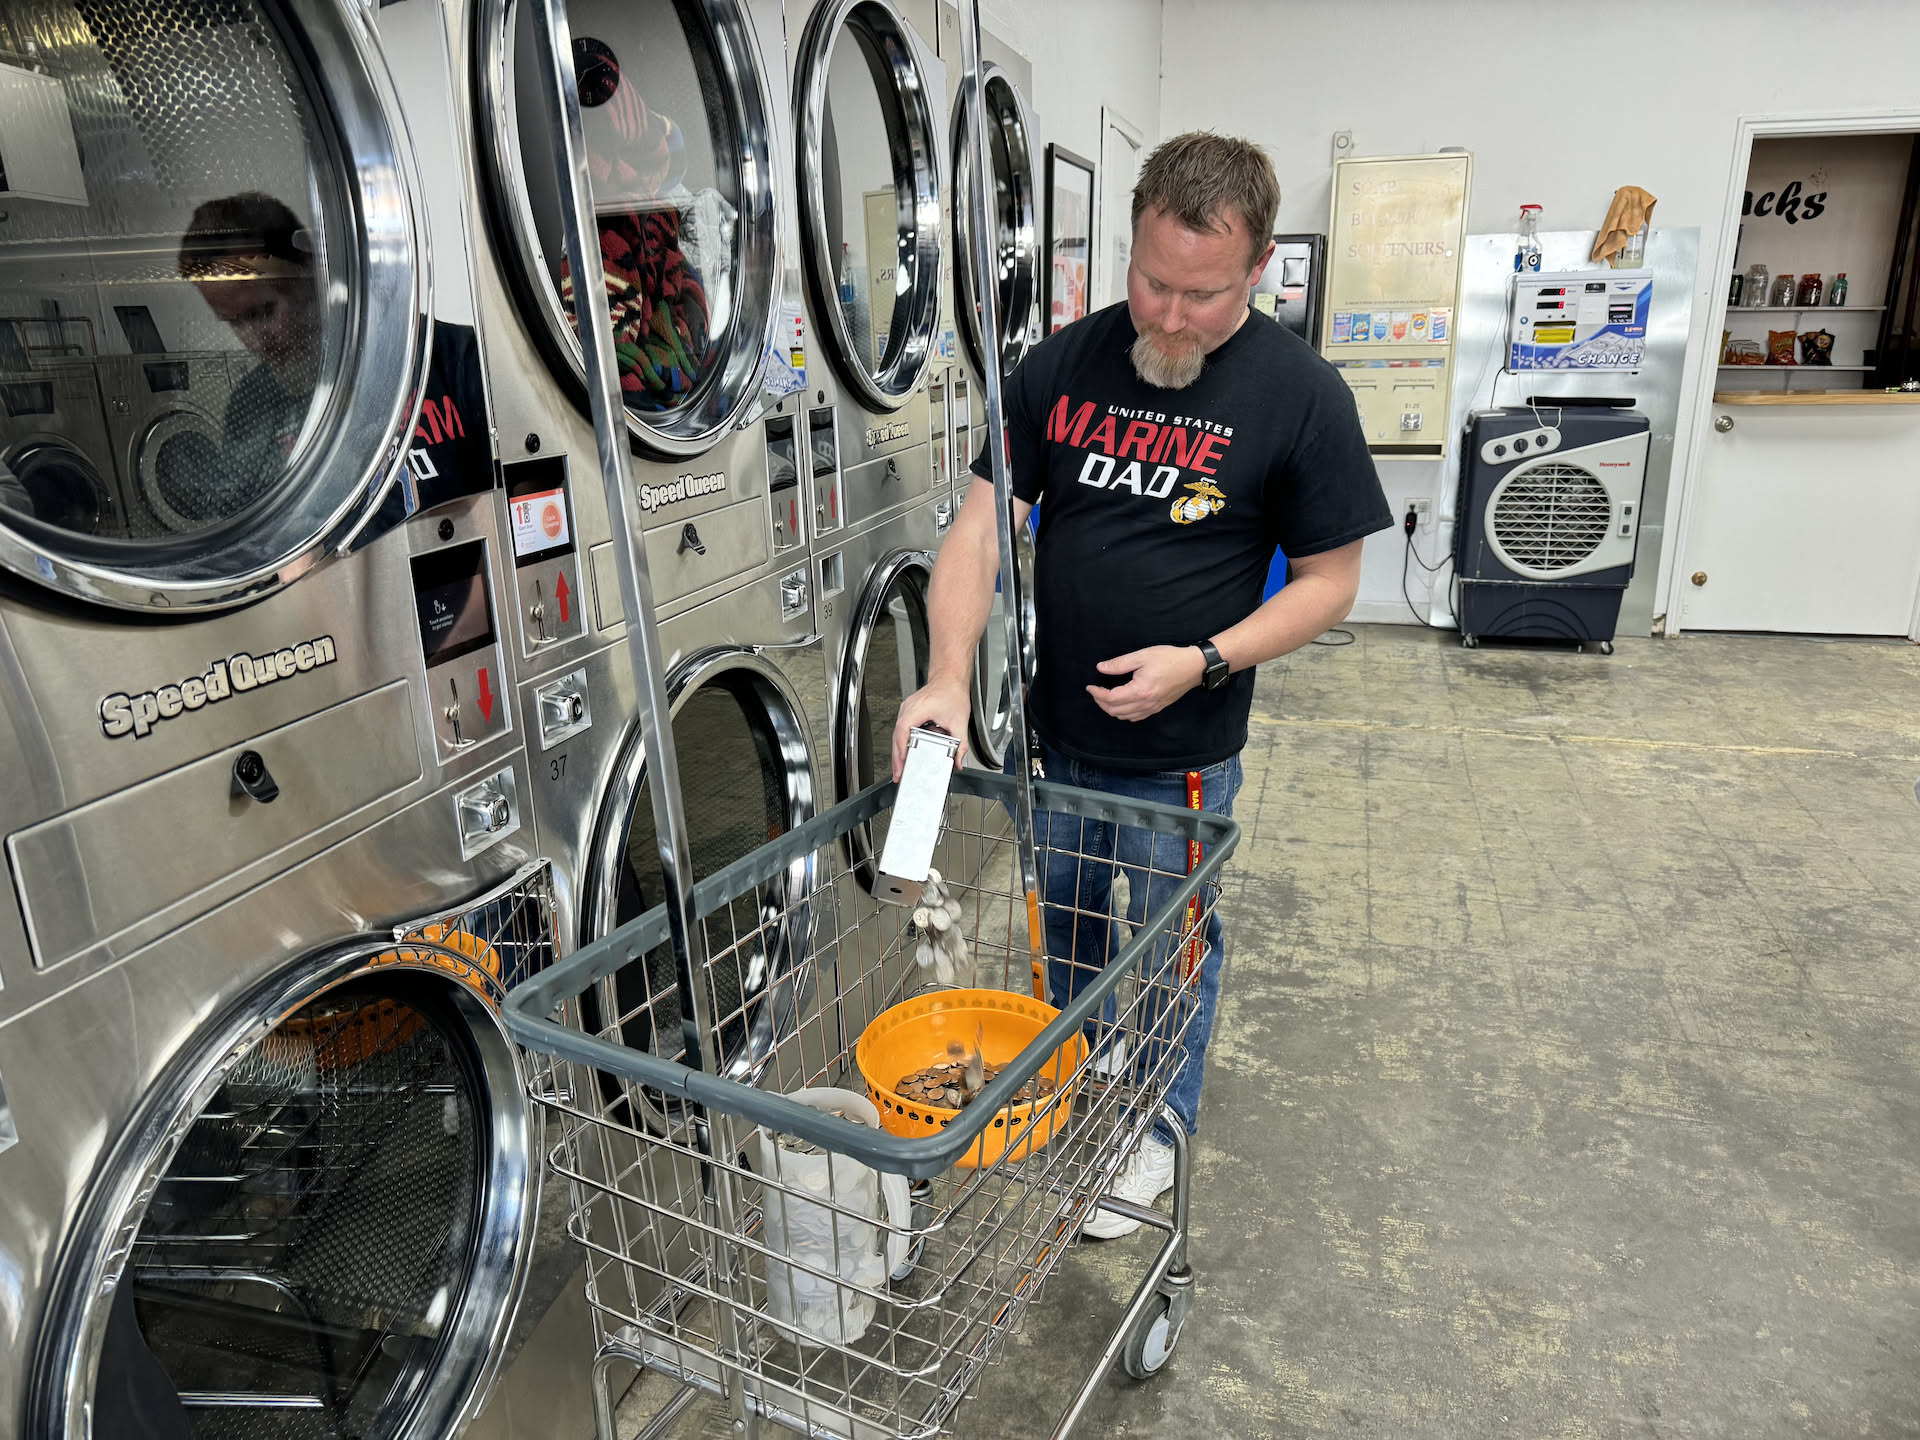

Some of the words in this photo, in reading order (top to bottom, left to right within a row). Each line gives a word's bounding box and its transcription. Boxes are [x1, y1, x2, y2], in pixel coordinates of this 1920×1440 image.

[1578, 353, 1640, 365] CHANGE
[1047, 394, 1231, 475] MARINE
[1108, 404, 1166, 424] UNITED
[1172, 415, 1235, 438] STATES
[639, 475, 686, 513] Speed
[684, 472, 726, 498] Queen
[1078, 452, 1180, 499] DAD
[823, 602, 833, 620] 39
[99, 659, 233, 740] Speed
[228, 635, 338, 693] Queen
[549, 754, 568, 782] 37
[1191, 789, 1200, 811] MAR
